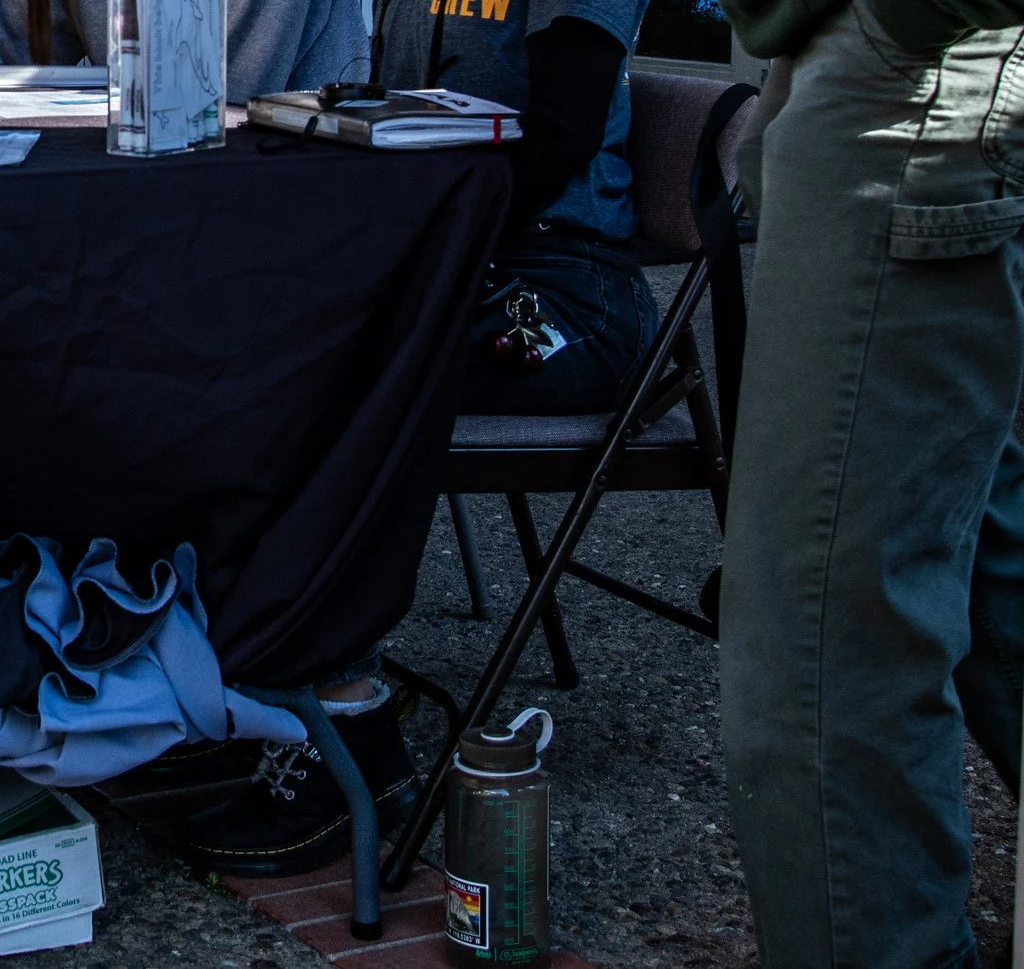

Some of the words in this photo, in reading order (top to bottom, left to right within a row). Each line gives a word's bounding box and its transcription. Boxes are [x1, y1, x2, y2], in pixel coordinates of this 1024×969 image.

[17, 848, 38, 862] LINE
[467, 885, 481, 894] PARK
[2, 914, 10, 923] in
[12, 911, 20, 920] 16
[22, 903, 54, 918] Different
[56, 897, 80, 909] Colors
